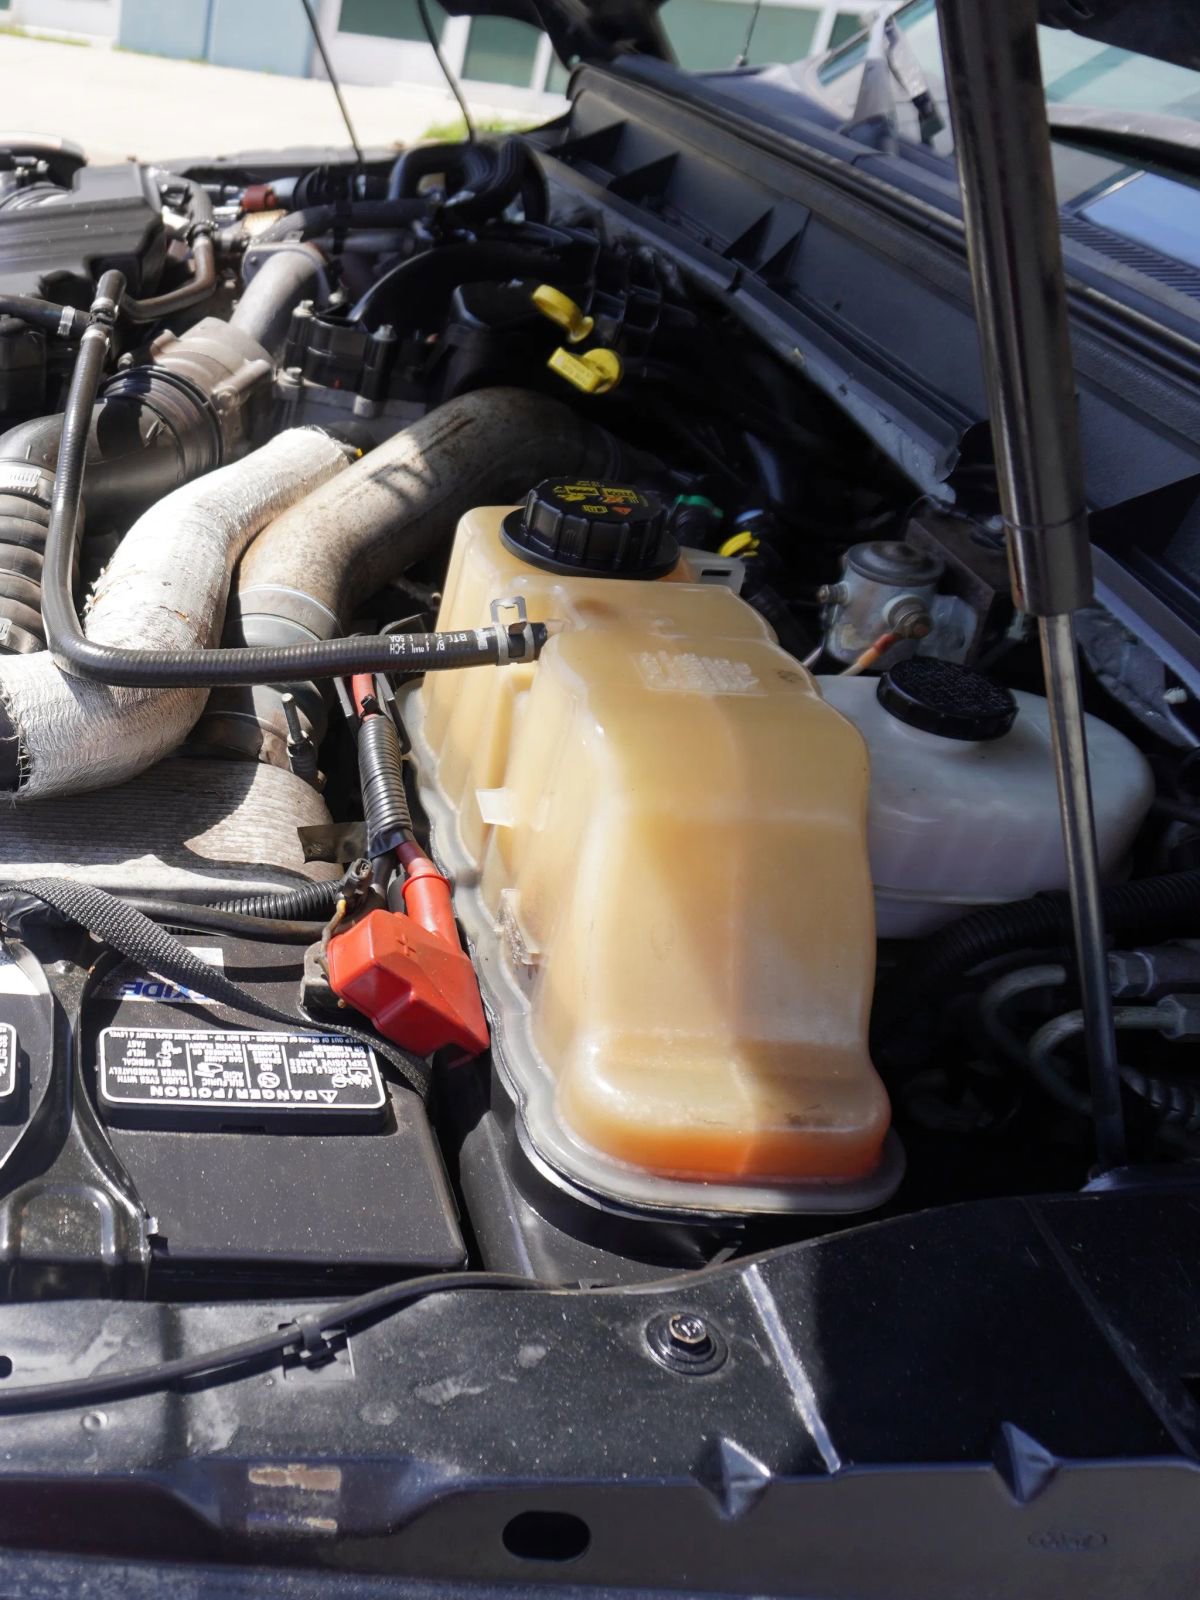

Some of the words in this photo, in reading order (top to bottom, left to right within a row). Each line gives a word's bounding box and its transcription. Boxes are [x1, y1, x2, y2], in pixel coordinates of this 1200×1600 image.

[121, 981, 208, 999] XIDE
[126, 1040, 146, 1048] FAST
[126, 1049, 146, 1057] HELP
[122, 1057, 155, 1066] MEDICAL
[157, 1059, 172, 1067] GET
[289, 1058, 318, 1066] GASES
[321, 1059, 368, 1067] EXPLOSIVE
[108, 1067, 158, 1076] IMMEDIATELY
[161, 1069, 186, 1077] WATER
[290, 1066, 313, 1074] EYES
[316, 1066, 347, 1075] SHIELD
[222, 1071, 243, 1079] ACID
[117, 1075, 137, 1084] WITH
[140, 1076, 160, 1084] EYES
[162, 1077, 188, 1085] FLUSH
[201, 1077, 244, 1087] SULFURIC
[150, 1085, 318, 1100] DANGER/POISON
